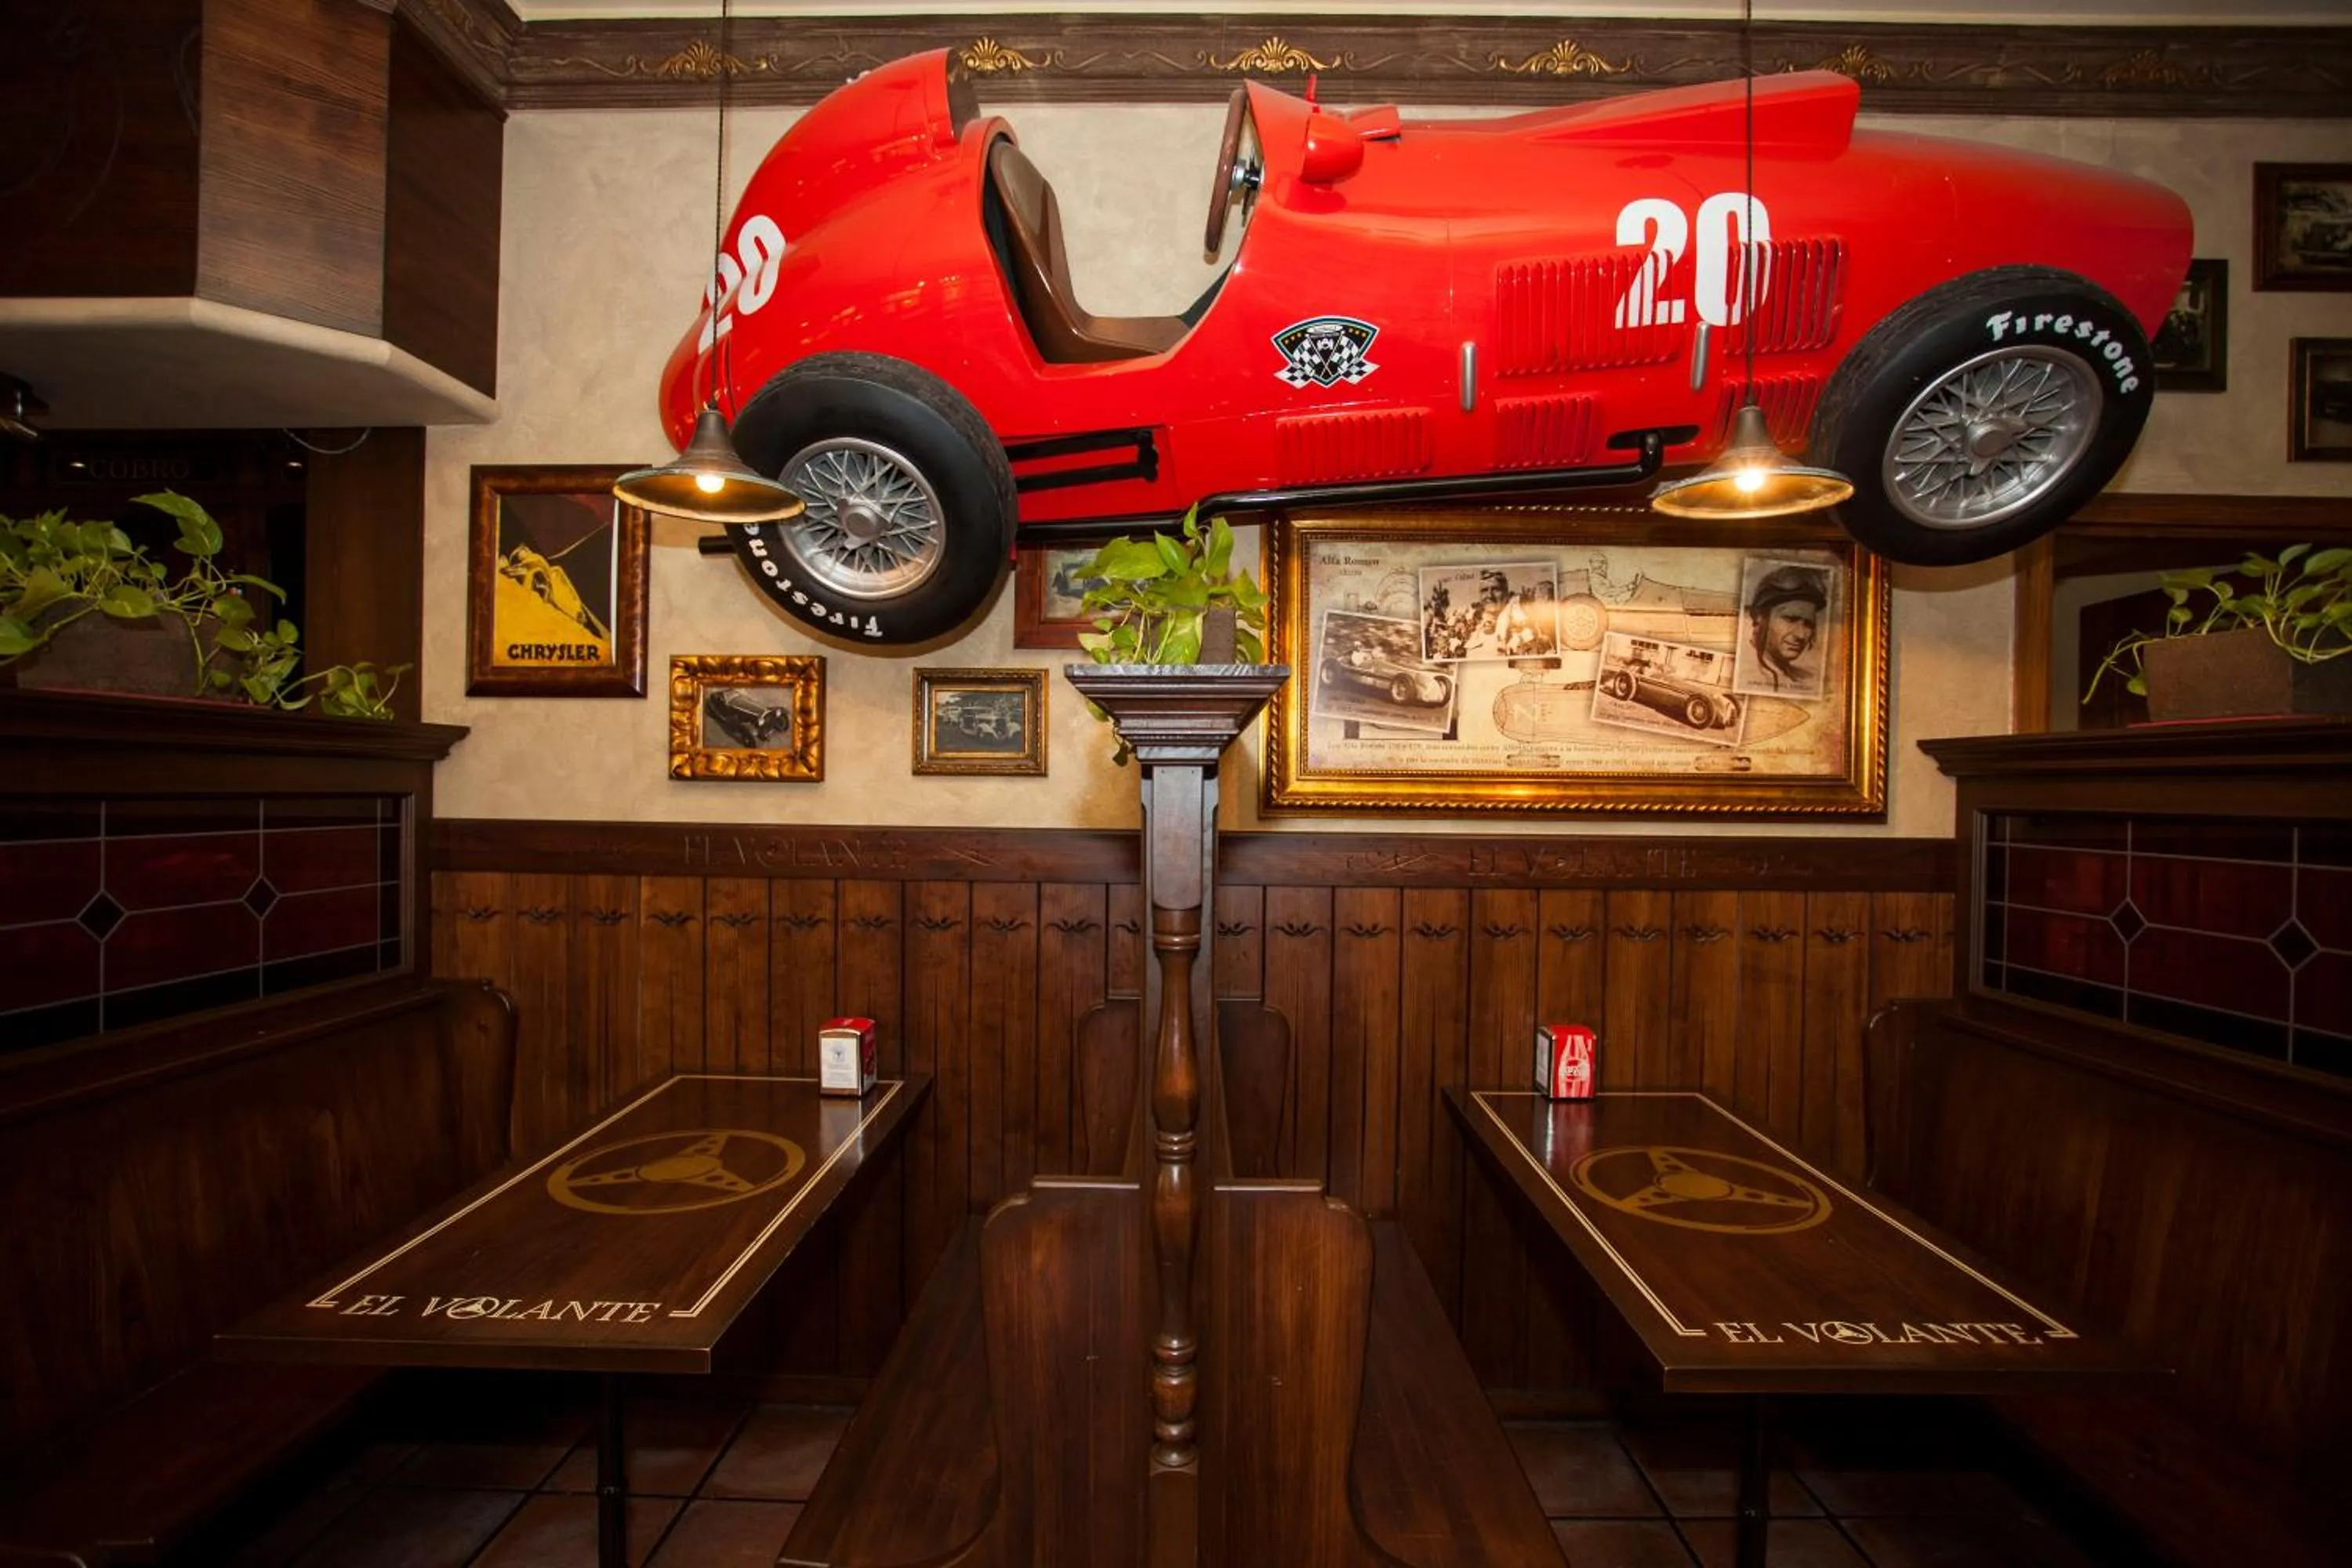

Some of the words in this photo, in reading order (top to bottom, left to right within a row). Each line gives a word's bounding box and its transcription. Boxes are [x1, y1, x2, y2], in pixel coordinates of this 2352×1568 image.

[698, 214, 786, 355] 20
[1615, 191, 1773, 330] 20
[1986, 310, 2139, 394] Firestone
[744, 523, 883, 637] Firestone
[506, 643, 600, 661] CHRYSLER
[339, 1294, 406, 1316] EL
[420, 1295, 662, 1323] VOLANTE
[1712, 1321, 1785, 1344] EL
[1780, 1320, 2044, 1345] VOLANTE
